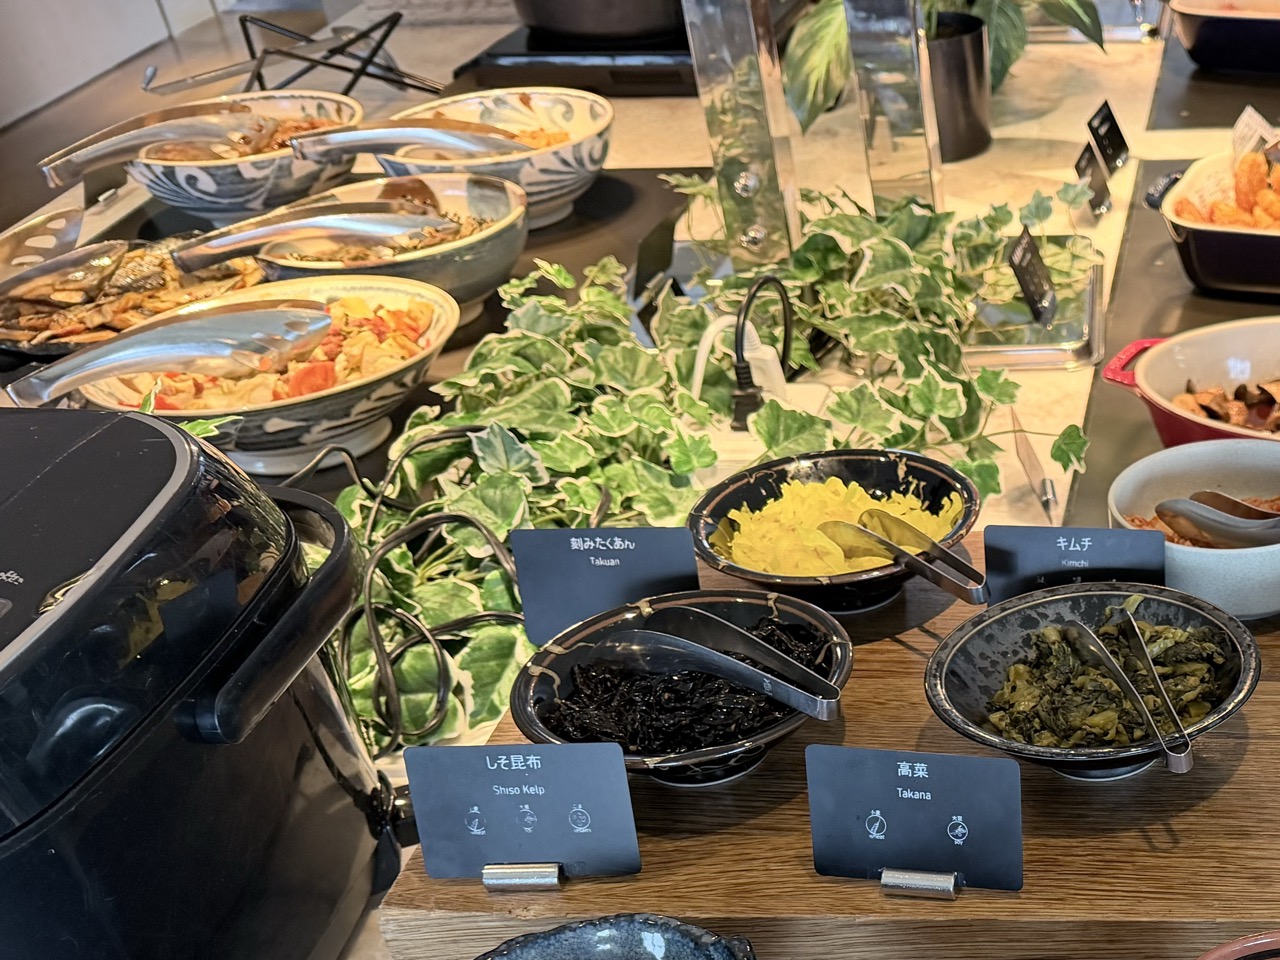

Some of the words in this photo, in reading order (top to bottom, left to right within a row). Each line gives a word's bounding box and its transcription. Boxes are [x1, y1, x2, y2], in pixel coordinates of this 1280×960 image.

[570, 537, 635, 550] 刻みたくあん
[1057, 537, 1092, 551] キムチ
[590, 557, 620, 566] Takuan
[1061, 559, 1089, 568] Kimchi
[486, 755, 541, 770] しそ昆布
[897, 761, 928, 778] 高菜
[493, 785, 521, 795] Shiso
[523, 785, 545, 795] Kelp
[897, 788, 931, 800] Takana
